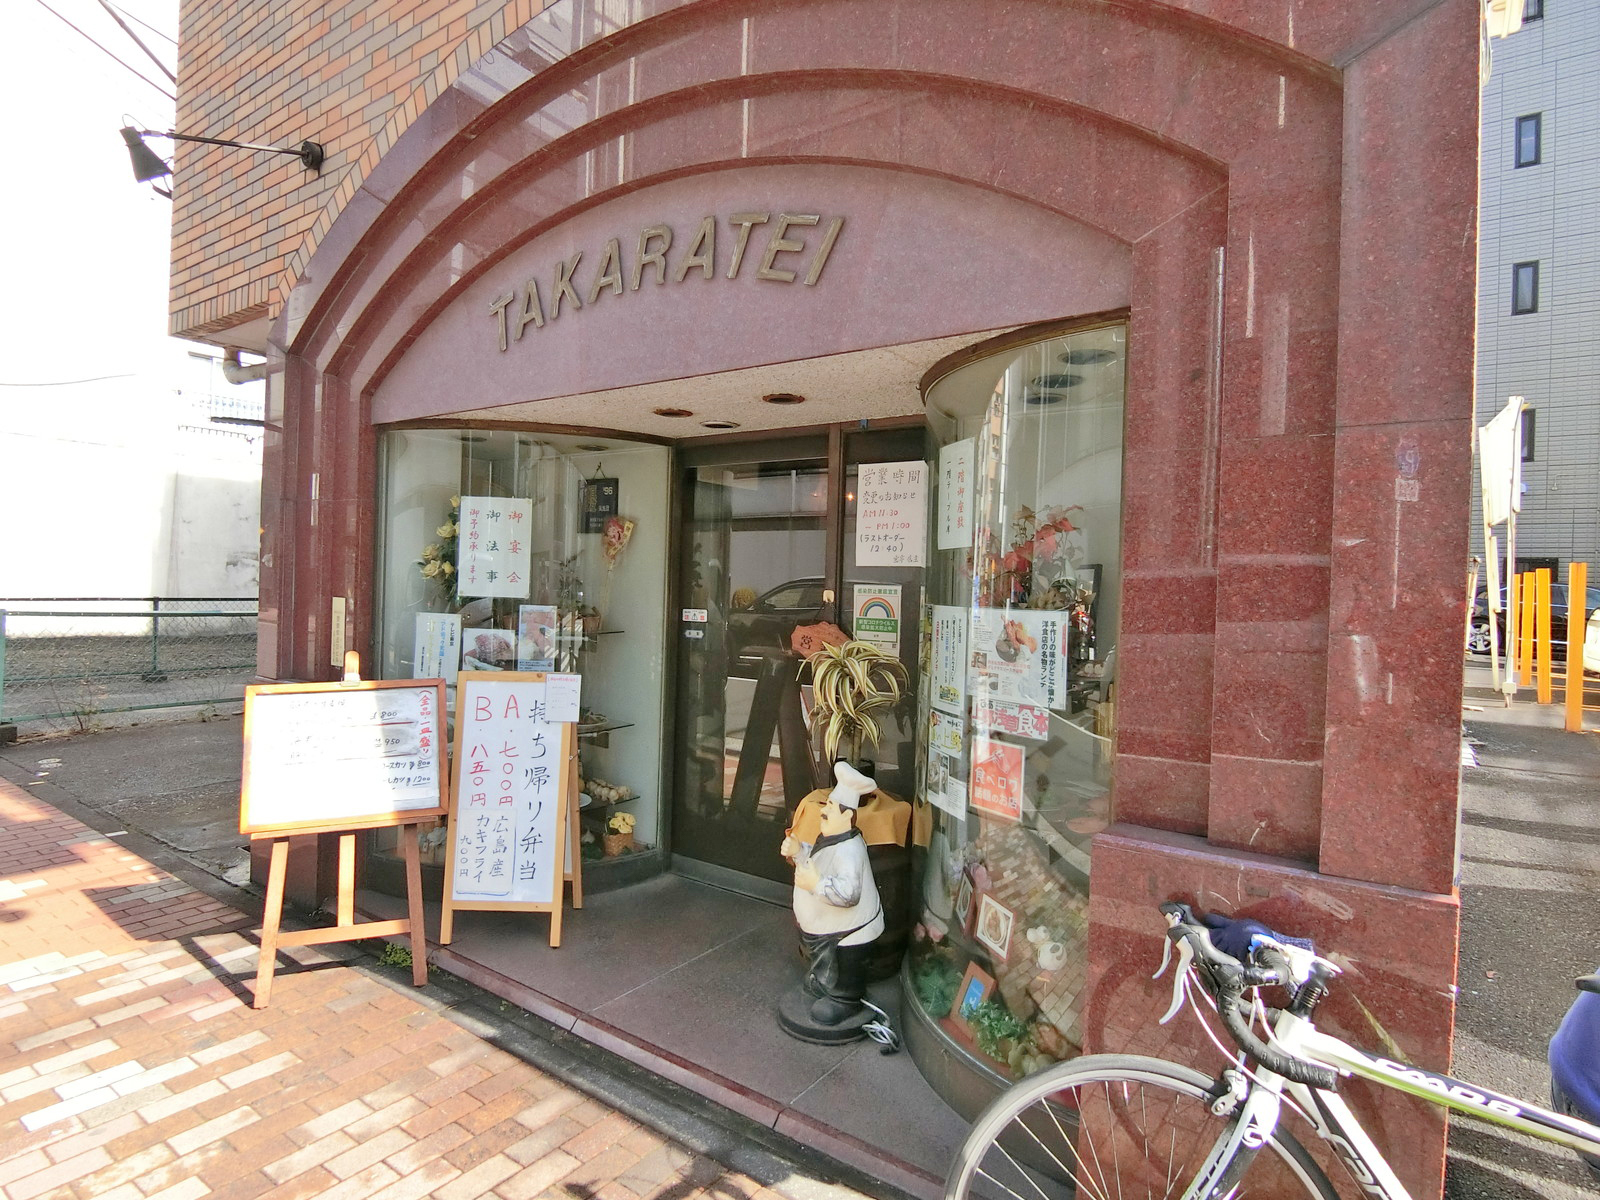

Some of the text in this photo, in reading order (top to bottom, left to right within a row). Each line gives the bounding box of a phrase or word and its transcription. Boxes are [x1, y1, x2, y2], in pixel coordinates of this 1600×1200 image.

[488, 211, 847, 352] TAKARATEI
[862, 467, 921, 487] 営業時間
[467, 508, 480, 584] 御予約承ります
[485, 509, 501, 583] 御法事
[506, 510, 524, 583] 御宴会
[473, 814, 491, 883] カキフライ
[489, 815, 509, 878] 広島産
